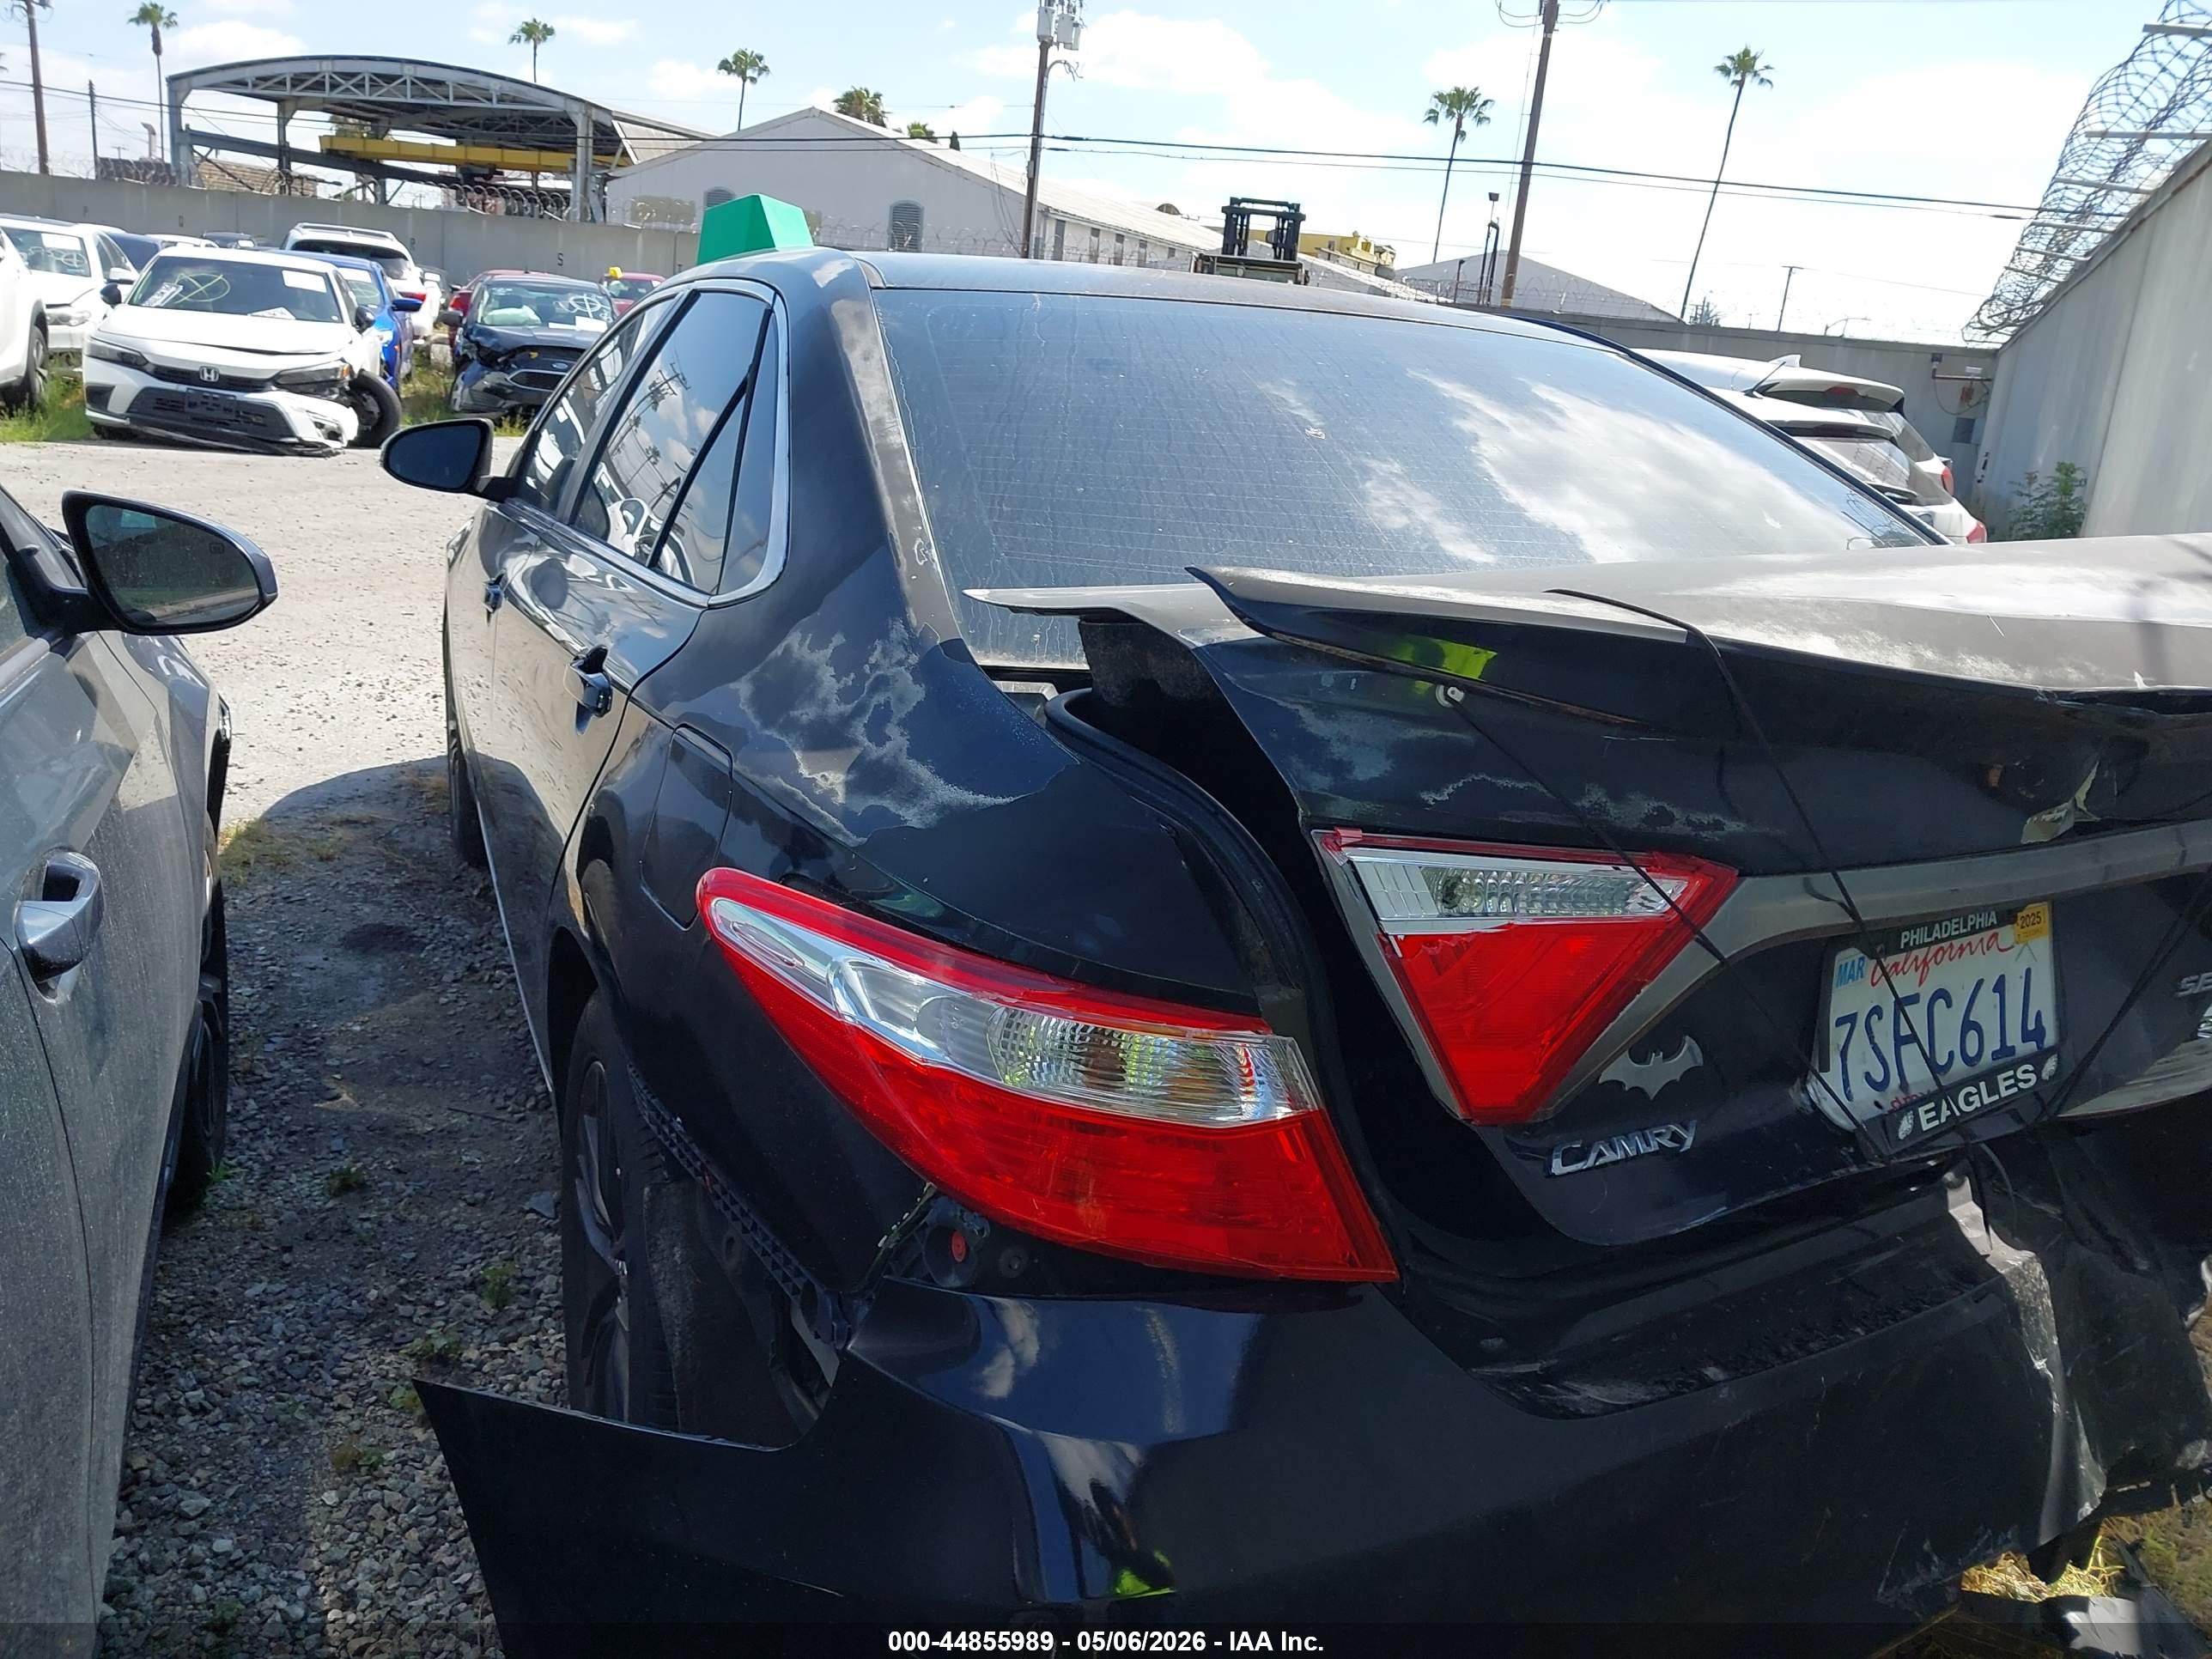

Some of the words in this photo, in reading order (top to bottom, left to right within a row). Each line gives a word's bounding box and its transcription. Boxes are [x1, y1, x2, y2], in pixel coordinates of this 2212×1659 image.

[556, 252, 564, 267] S
[1900, 910, 1997, 949] PHILADELPHIA
[2020, 911, 2042, 929] 2025
[1836, 955, 1866, 988] MAR
[1870, 931, 2014, 988] California
[1835, 967, 2047, 1102] 7SFC614
[1917, 1064, 2038, 1132] EAGLES
[1551, 1120, 1697, 1176] CAMRY
